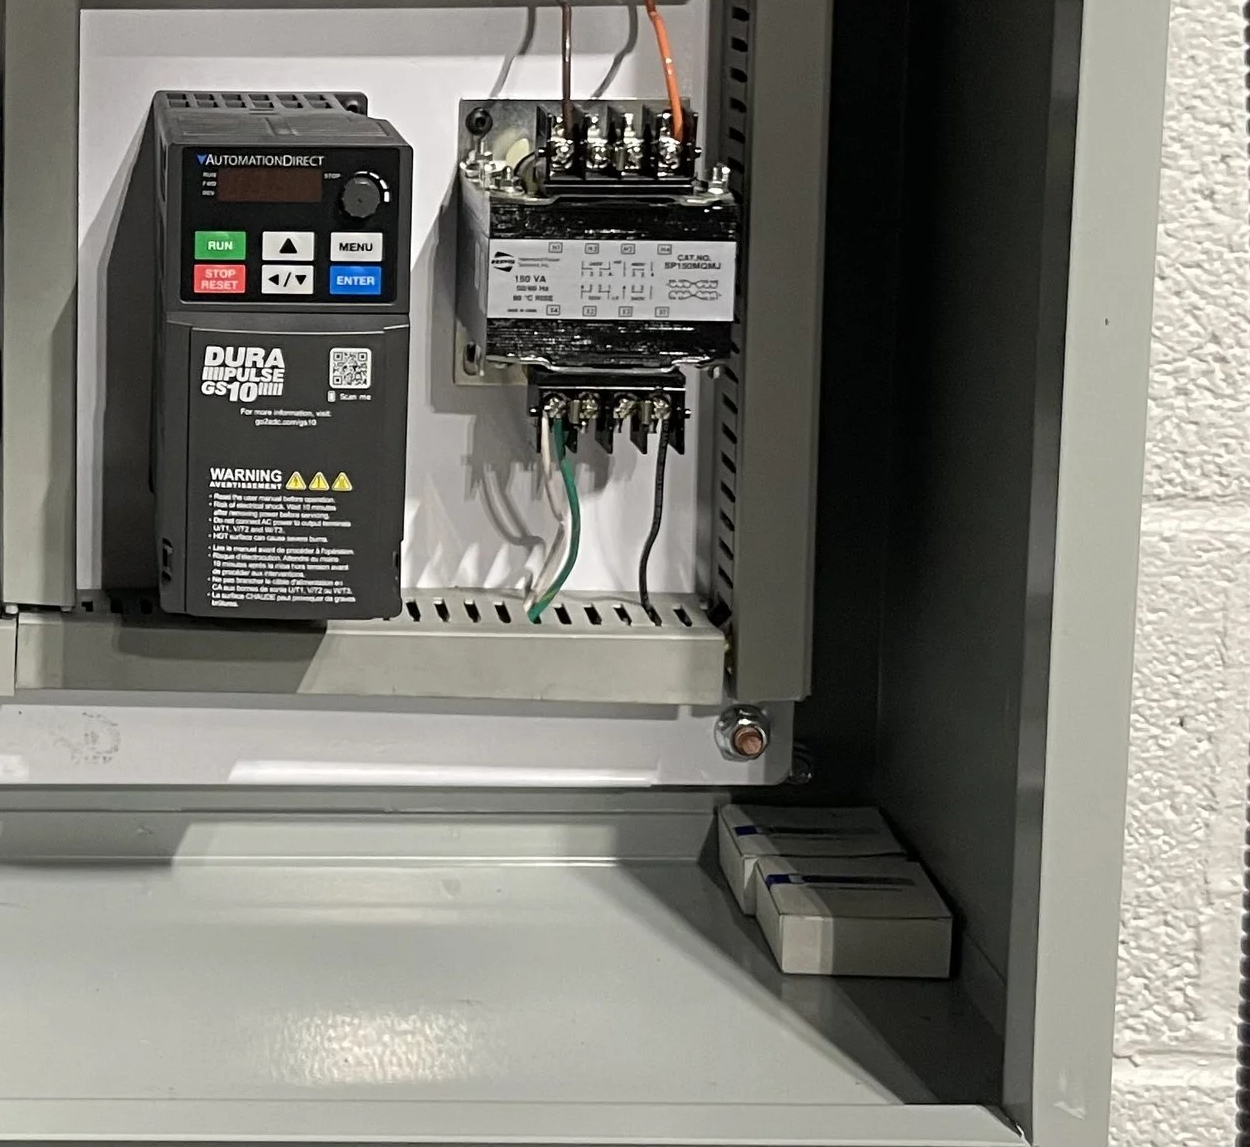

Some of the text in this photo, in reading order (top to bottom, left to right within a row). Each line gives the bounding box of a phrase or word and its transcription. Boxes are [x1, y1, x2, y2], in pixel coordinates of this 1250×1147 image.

[207, 241, 233, 251] RUN
[339, 243, 373, 252] MENU
[204, 269, 235, 278] STOP
[201, 280, 238, 290] RESET
[336, 276, 375, 286] ENTER
[205, 346, 284, 368] DURA
[223, 366, 284, 382] PULSE
[201, 381, 258, 402] GS10
[210, 468, 282, 482] WARNING
